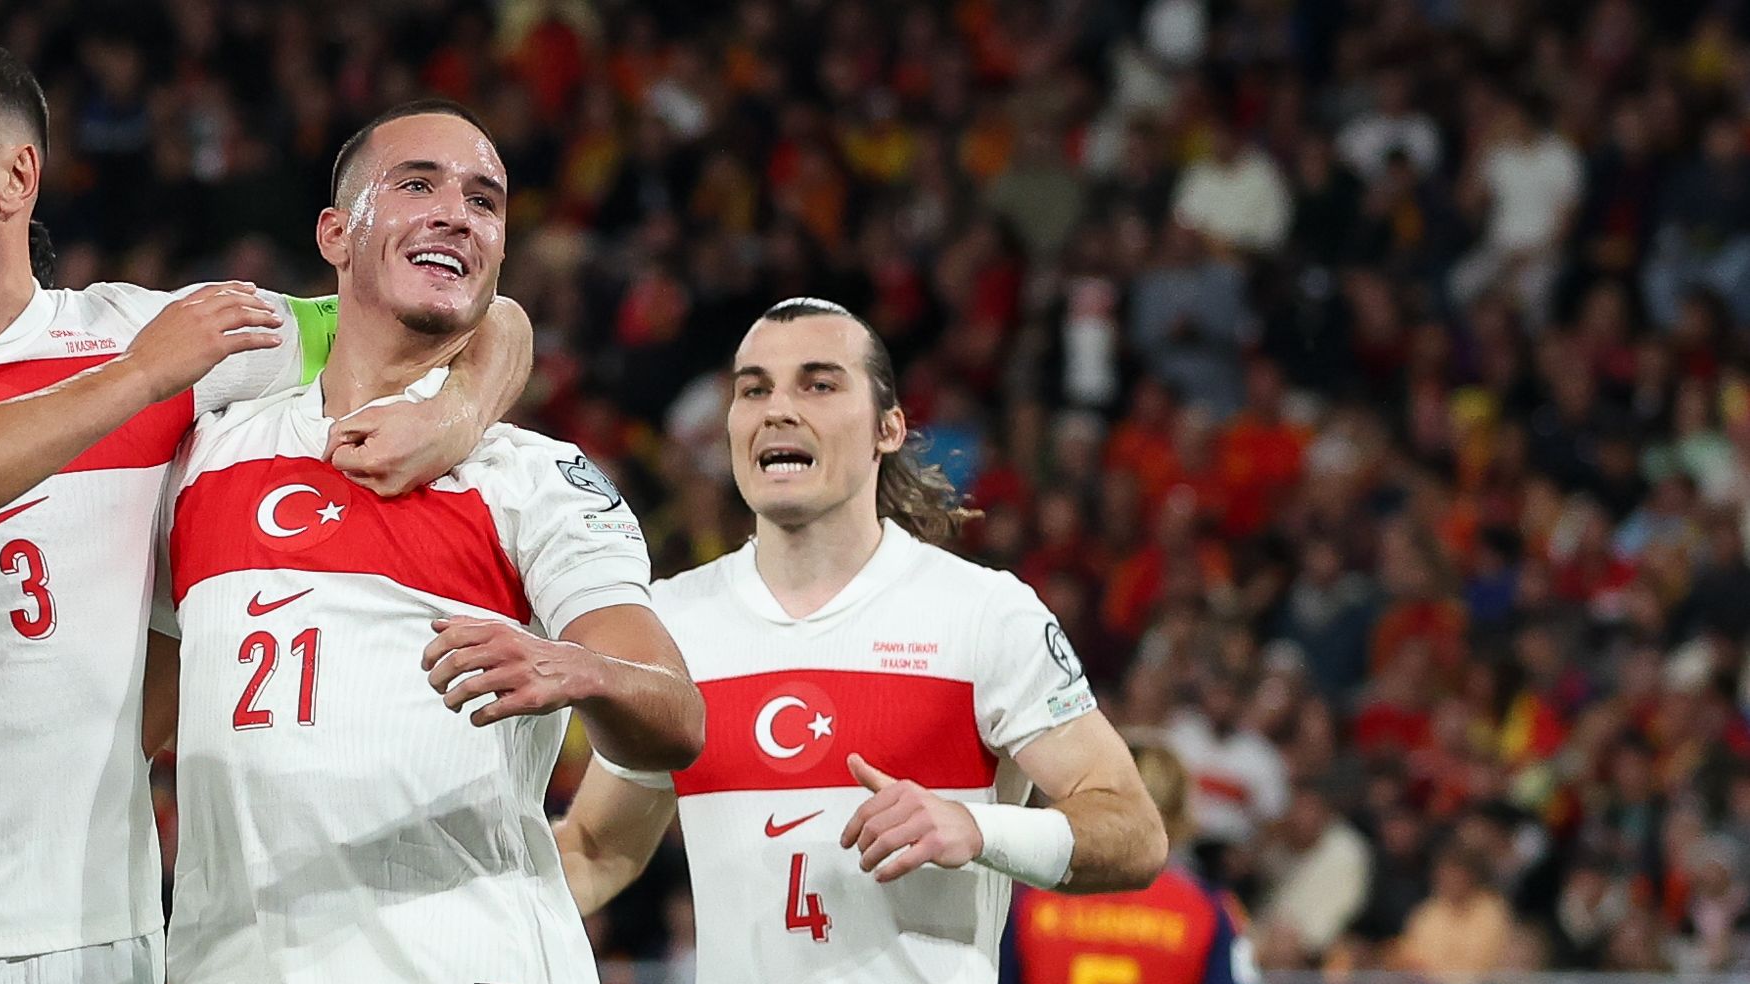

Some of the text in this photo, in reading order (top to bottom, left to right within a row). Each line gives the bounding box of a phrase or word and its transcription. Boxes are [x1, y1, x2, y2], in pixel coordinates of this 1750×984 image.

[75, 339, 99, 352] KASIM
[232, 627, 322, 731] 21
[785, 851, 833, 942] 4
